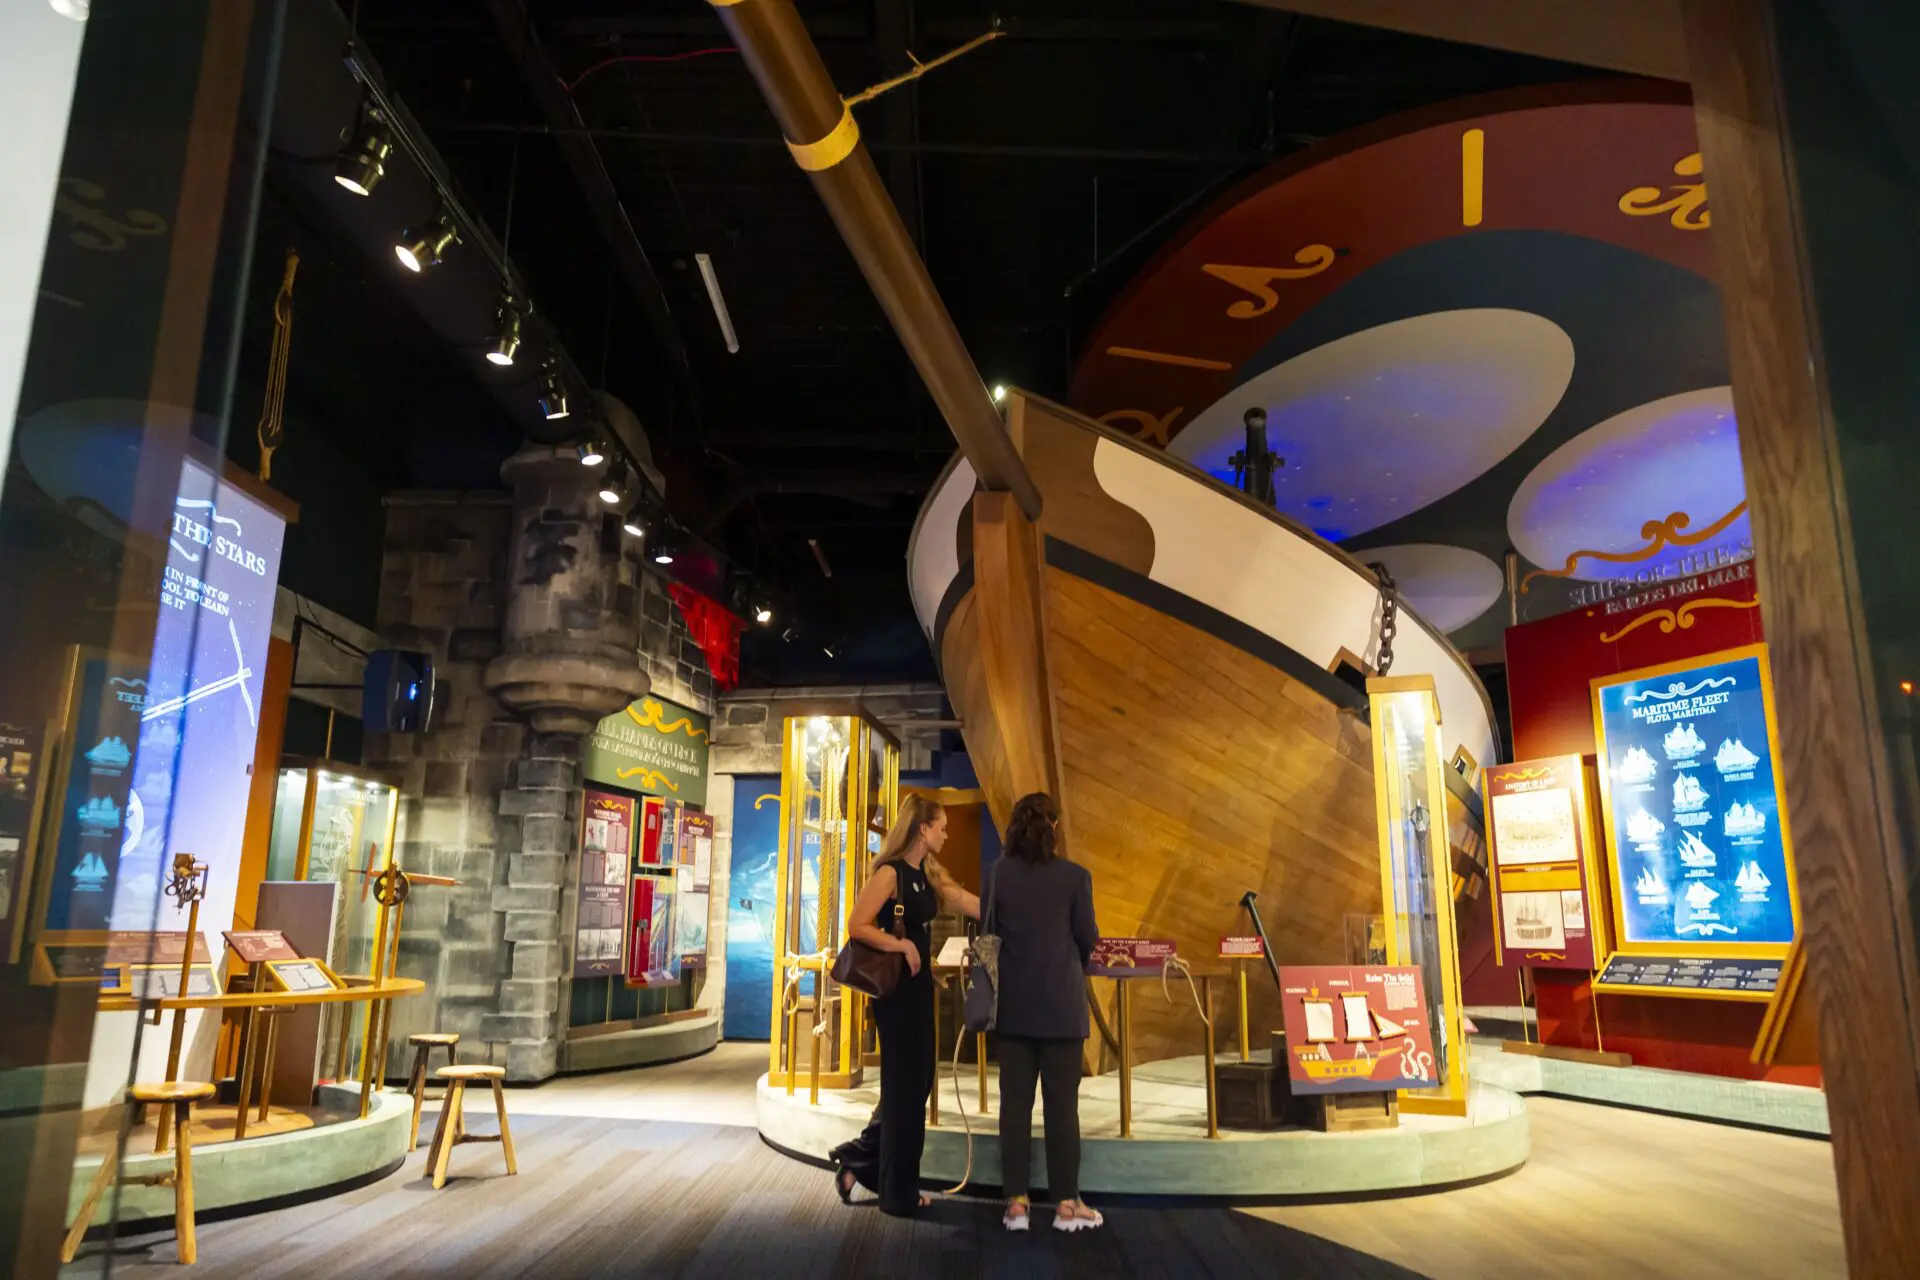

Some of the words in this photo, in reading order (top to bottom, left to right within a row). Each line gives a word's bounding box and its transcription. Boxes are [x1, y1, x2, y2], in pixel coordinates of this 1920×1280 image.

[172, 512, 212, 549] THE
[215, 535, 266, 576] STARS
[1634, 565, 1666, 588] OF
[1678, 544, 1734, 578] THE
[1706, 564, 1749, 589] MAR
[170, 567, 185, 582] IN
[184, 574, 218, 598] FRONT
[217, 590, 230, 603] OF
[173, 598, 186, 611] IT
[184, 588, 200, 603] TO
[200, 595, 229, 617] LEARN
[1632, 699, 1689, 719] MARITIME
[1692, 692, 1729, 707] FLEET
[1646, 713, 1671, 725] FLOTA
[596, 718, 620, 738] ALL
[620, 724, 657, 752] HANDS
